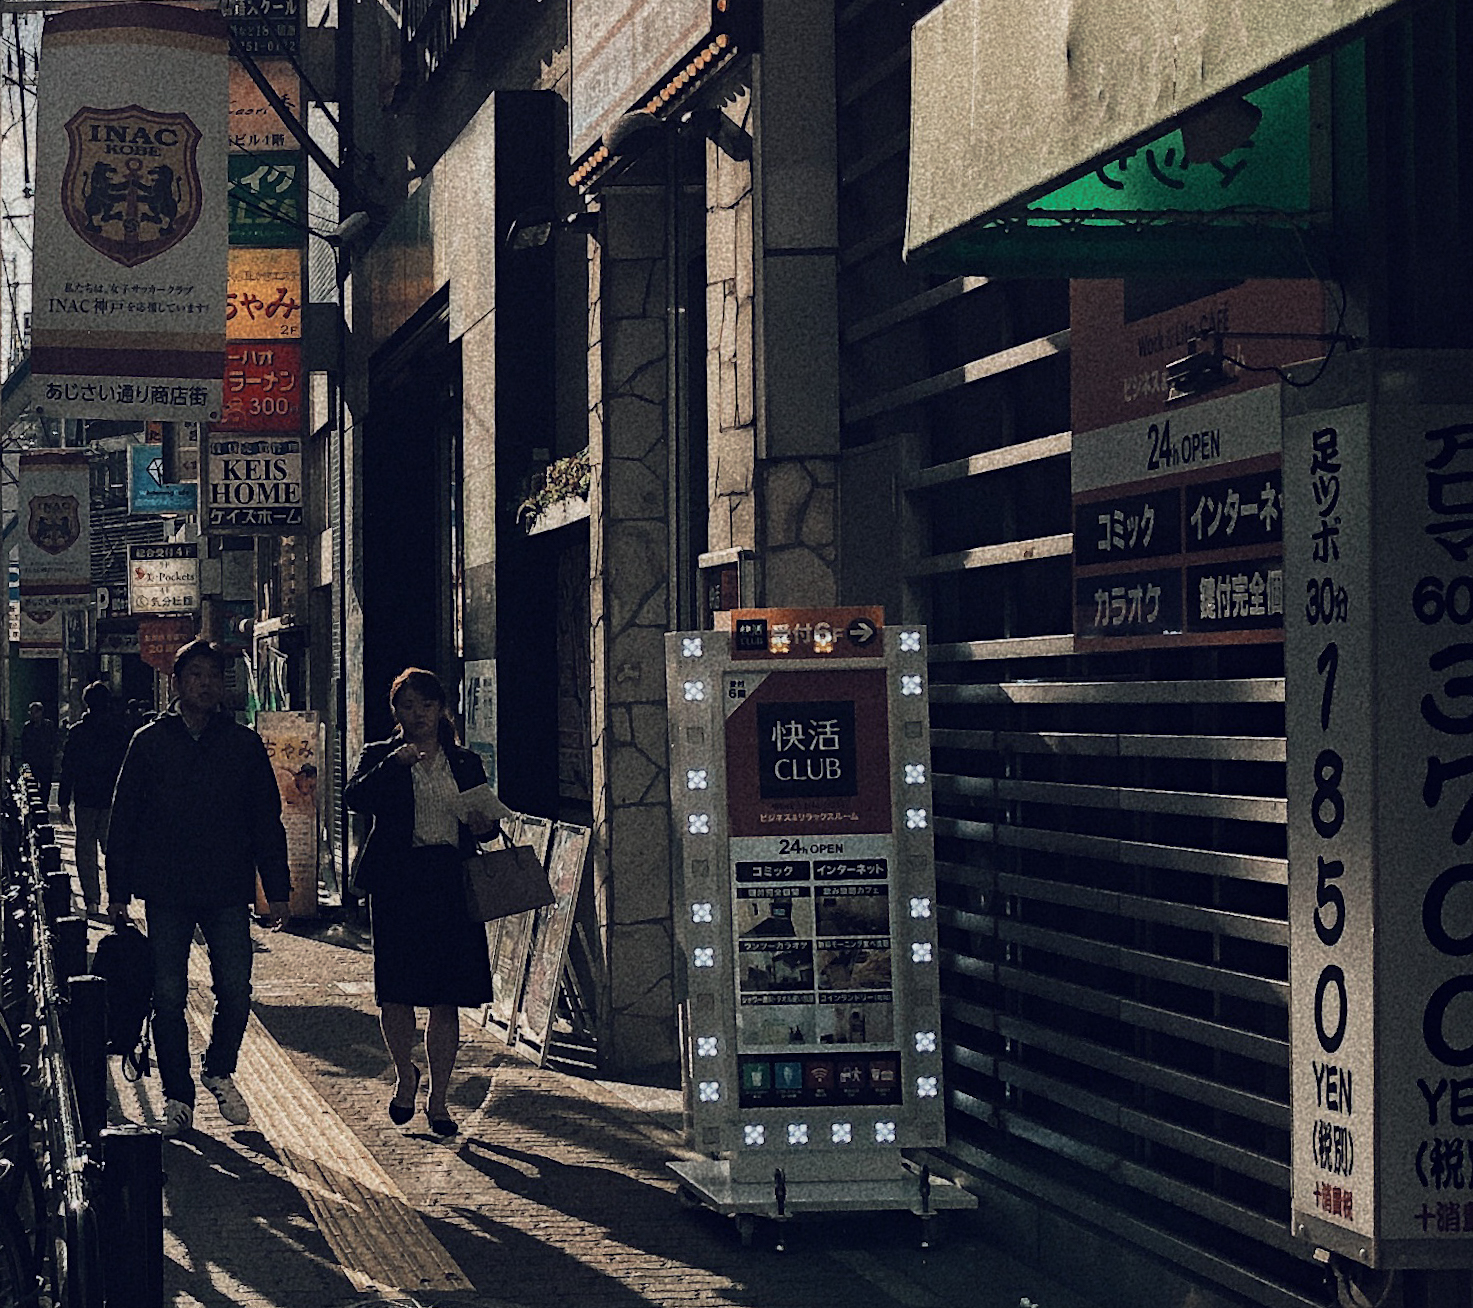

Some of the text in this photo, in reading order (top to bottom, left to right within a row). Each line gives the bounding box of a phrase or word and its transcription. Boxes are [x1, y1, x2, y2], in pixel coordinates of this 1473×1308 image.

[88, 124, 179, 147] INAC
[104, 143, 162, 157] KOBE
[280, 324, 299, 336] 2F
[228, 370, 296, 392] ラーメン
[45, 382, 208, 407] あじさい通り商店街
[1180, 428, 1221, 465] OPEN
[222, 458, 288, 481] KEIS
[210, 482, 301, 505] HOME
[1309, 427, 1342, 564] 足ツボ
[210, 509, 302, 526] ケイスホーム
[1097, 481, 1284, 552] コミック インターネ
[1093, 582, 1162, 628] カラオケ
[770, 718, 841, 752] 快活
[773, 757, 842, 781] CLUB
[809, 843, 844, 854] OPEN
[752, 863, 884, 878] コミック インターネット
[1312, 1060, 1352, 1117] YEN
